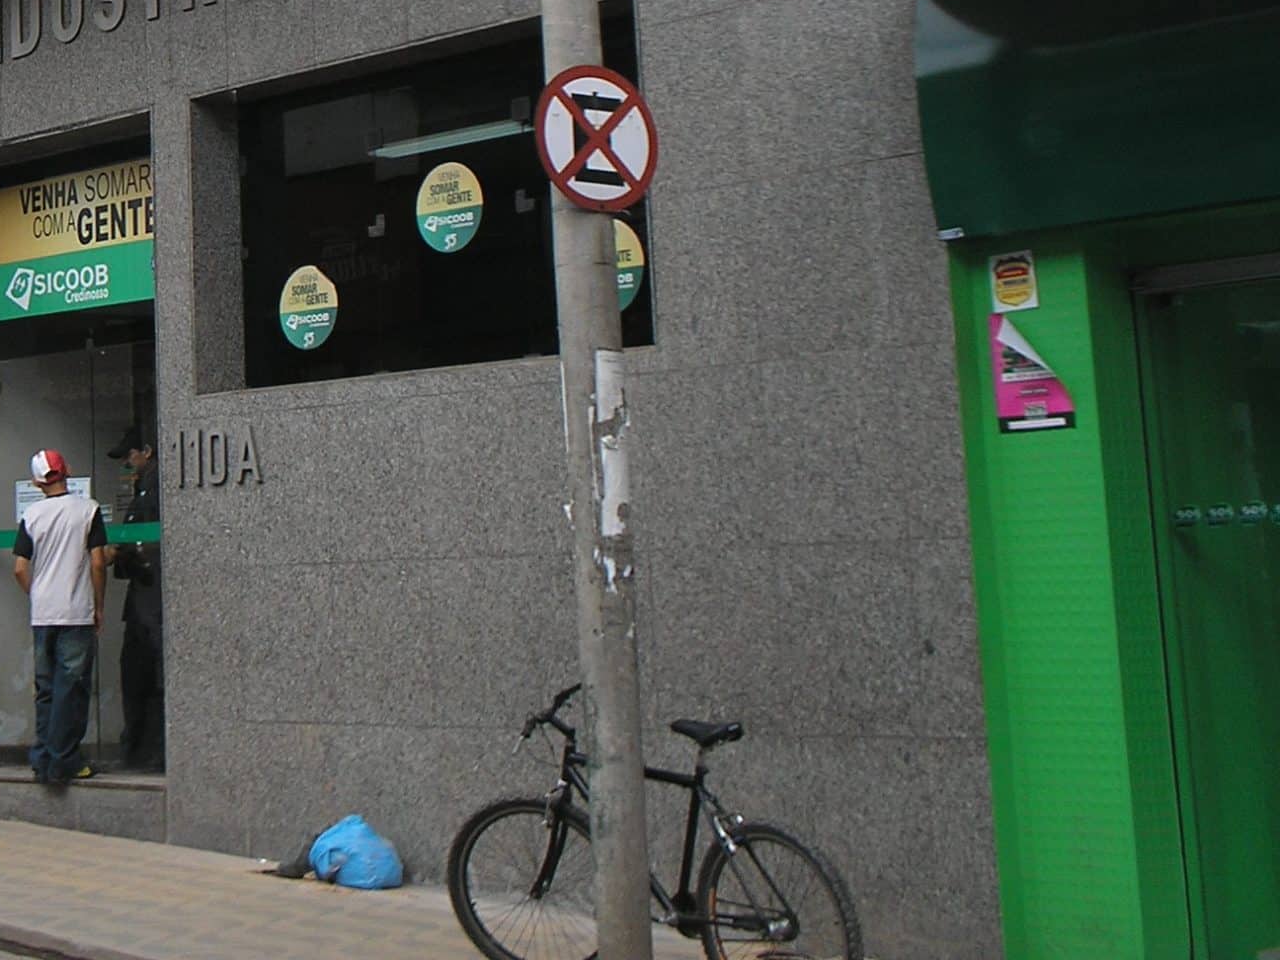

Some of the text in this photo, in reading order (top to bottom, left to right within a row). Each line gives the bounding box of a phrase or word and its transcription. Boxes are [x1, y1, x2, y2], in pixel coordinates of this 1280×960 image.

[21, 164, 151, 215] VENHA SOMAR
[430, 180, 459, 196] SOMAR
[447, 190, 473, 205] GENTE
[33, 197, 154, 245] COM A GENTE
[437, 212, 474, 226] SICOOB
[34, 264, 109, 295] SICOOB
[292, 283, 318, 297] SOMAR
[306, 292, 328, 305] GENTE
